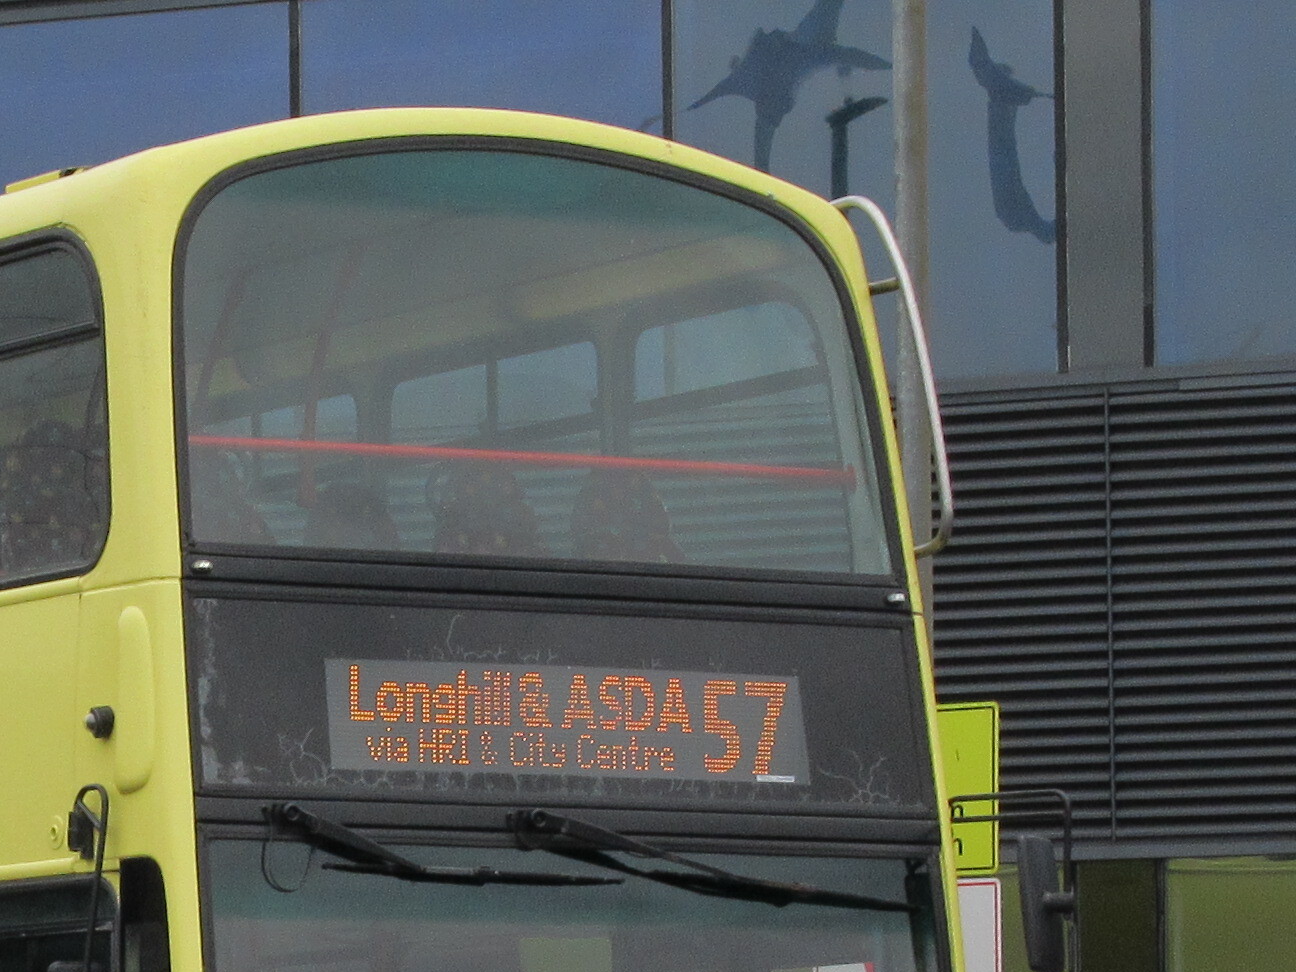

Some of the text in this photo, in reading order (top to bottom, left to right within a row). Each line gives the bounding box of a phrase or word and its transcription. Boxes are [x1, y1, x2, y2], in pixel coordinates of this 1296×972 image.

[348, 663, 693, 733] Longhill & ASDA
[703, 680, 789, 775] 57
[365, 726, 675, 772] via HRI & City Centre
